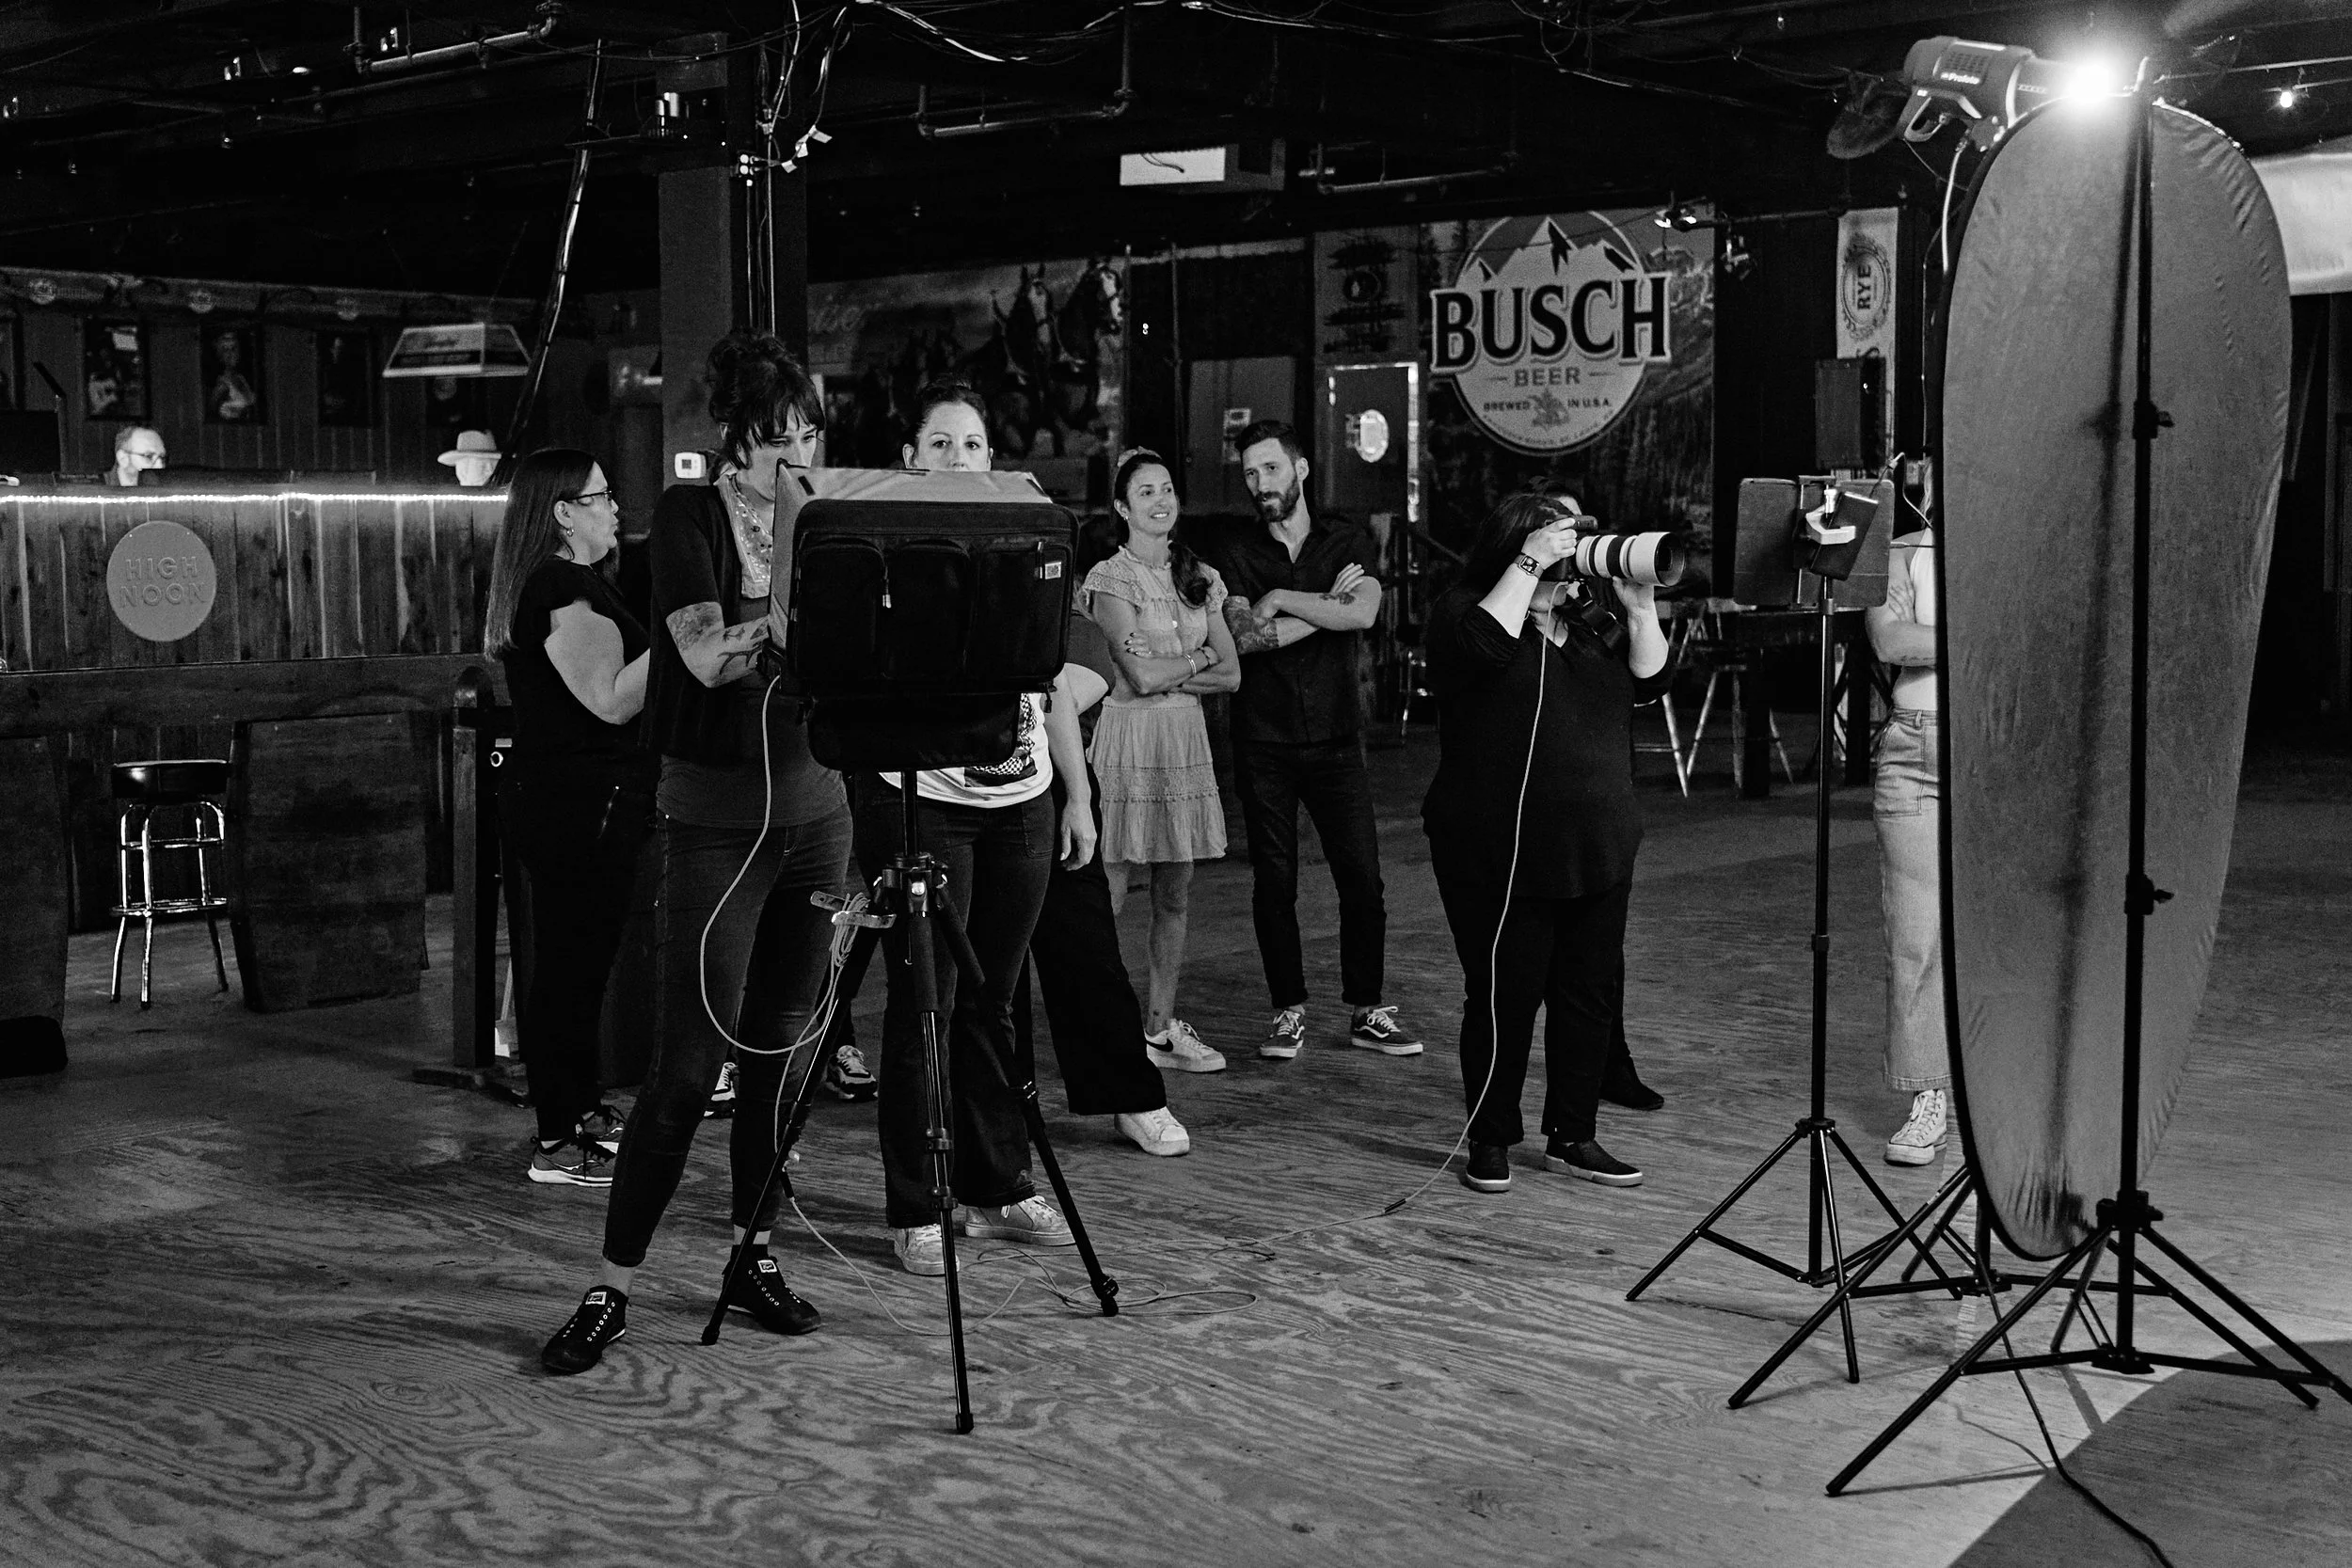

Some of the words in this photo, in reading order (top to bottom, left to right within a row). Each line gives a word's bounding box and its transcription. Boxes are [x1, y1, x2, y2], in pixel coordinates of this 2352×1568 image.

[1856, 264, 1871, 310] RYE
[1432, 276, 1669, 370] BUSCH
[1514, 366, 1581, 388] BEER
[1483, 400, 1531, 412] BREWED
[1567, 397, 1580, 408] IN
[125, 556, 199, 581] HIGH
[119, 581, 206, 609] NOON
